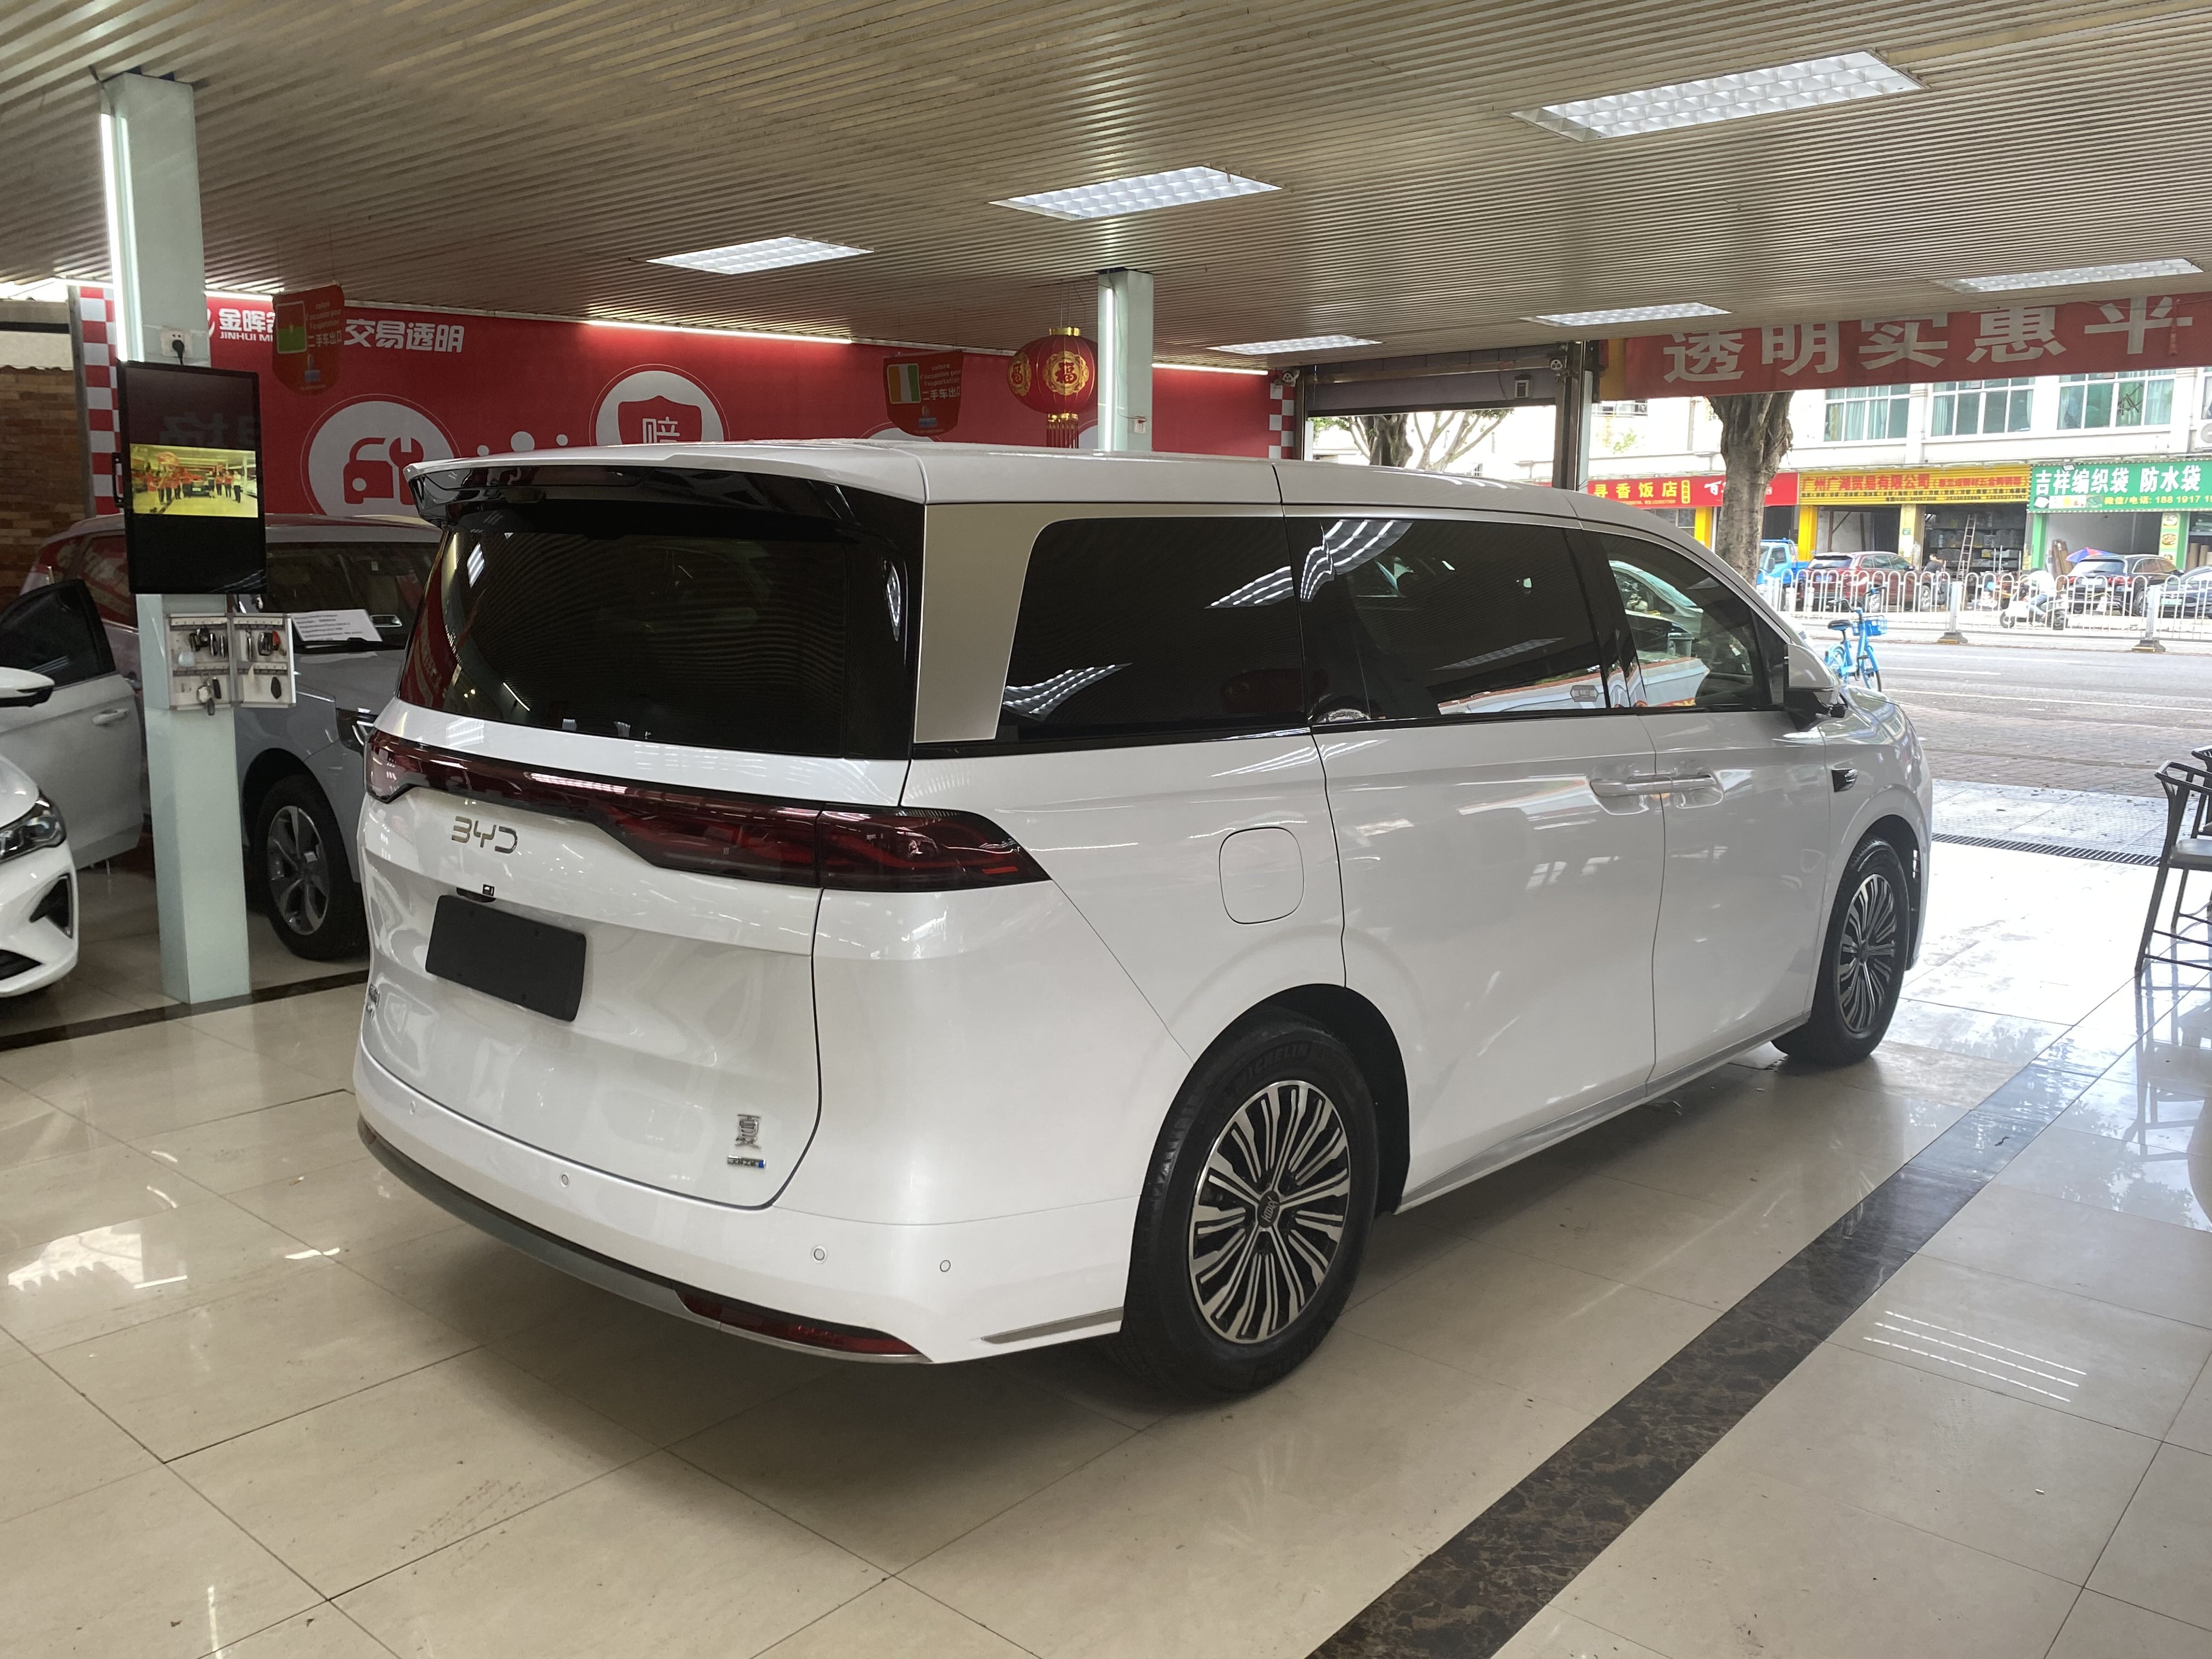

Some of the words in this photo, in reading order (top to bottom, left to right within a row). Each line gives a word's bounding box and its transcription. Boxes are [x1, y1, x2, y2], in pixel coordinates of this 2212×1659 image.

[219, 331, 257, 341] JINHUI
[343, 318, 465, 353] 交易透明
[1054, 361, 1078, 384] 福
[922, 386, 961, 400] 二手车出口
[1594, 481, 1678, 499] 寻香饭店
[2035, 467, 2129, 495] 吉祥编织袋
[2140, 465, 2201, 493] 防水袋
[2155, 495, 2174, 504] 188
[451, 816, 518, 854] BYD
